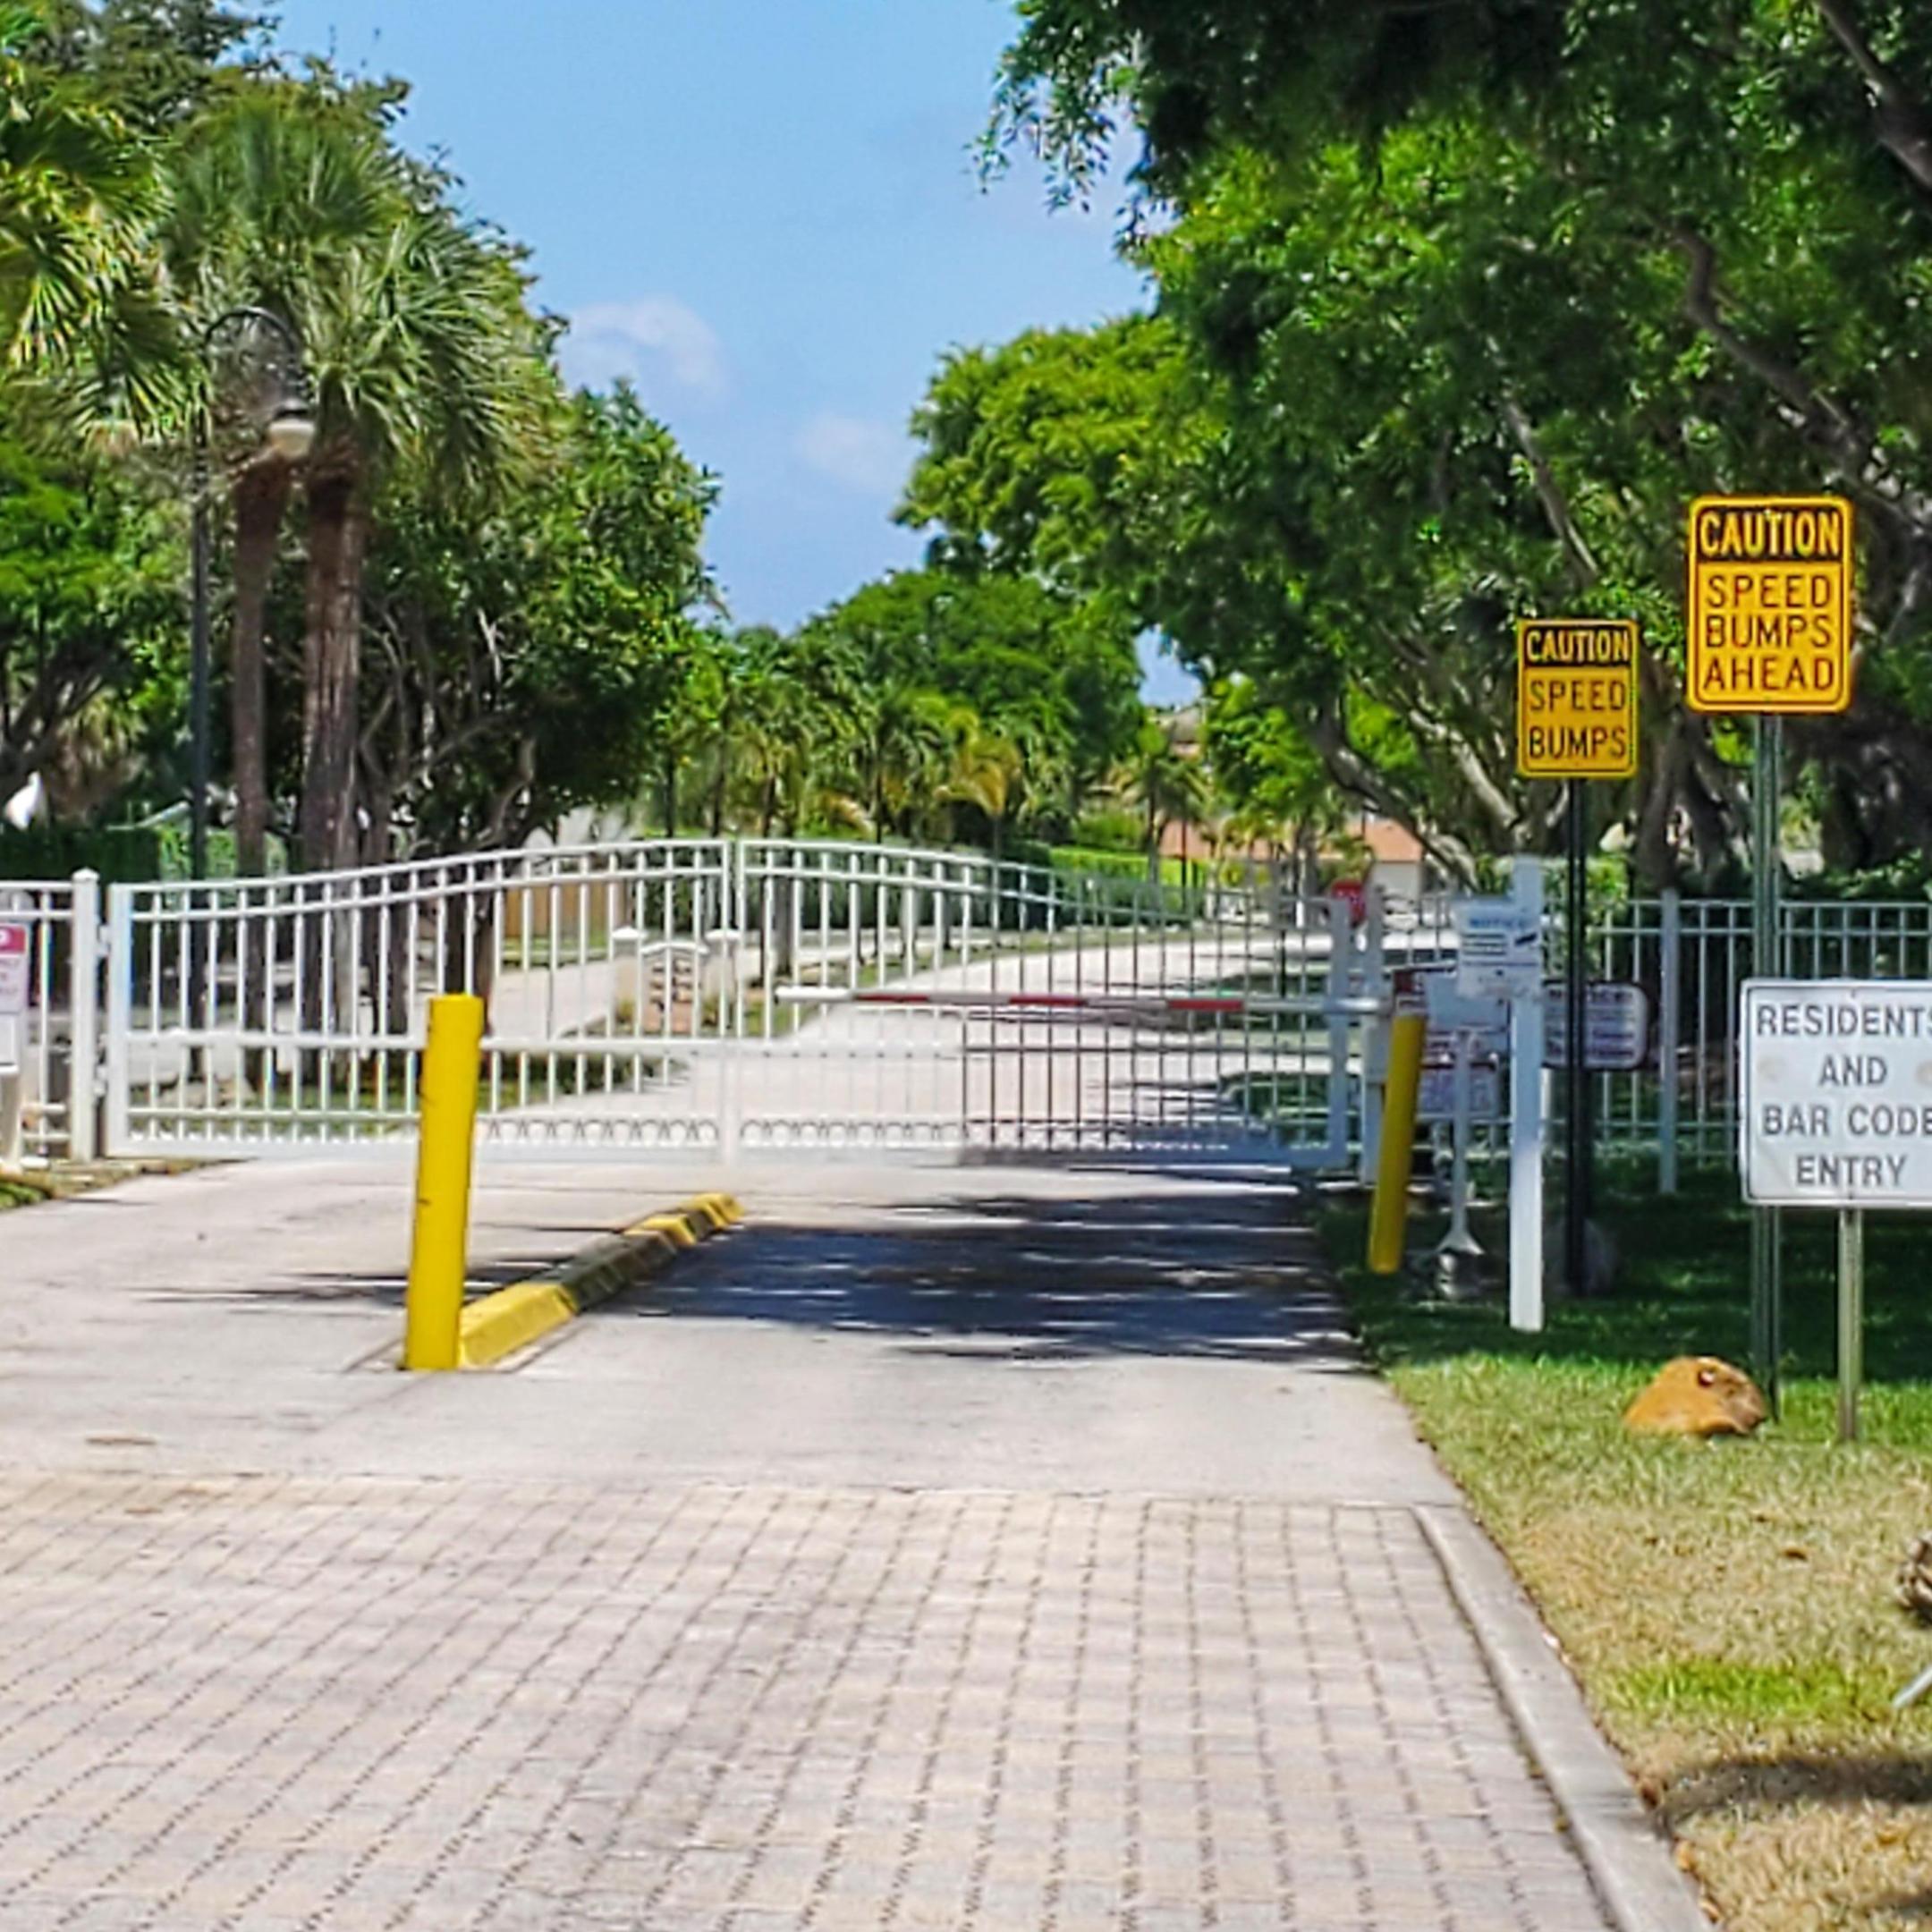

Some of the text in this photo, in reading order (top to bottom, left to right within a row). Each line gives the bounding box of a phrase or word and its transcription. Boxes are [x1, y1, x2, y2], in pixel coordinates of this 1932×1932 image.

[1699, 511, 1839, 555] CAUTION
[1706, 574, 1832, 608] SPEED
[1526, 629, 1629, 662] CAUTION
[1706, 614, 1831, 648] BUMPS
[1703, 657, 1834, 690] AHEAD
[1529, 680, 1626, 713] SPEED
[1529, 726, 1626, 759] BUMPS
[1818, 1055, 1887, 1086] AND
[1762, 1104, 1830, 1136] BAR
[1797, 1155, 1907, 1185] ENTRY
